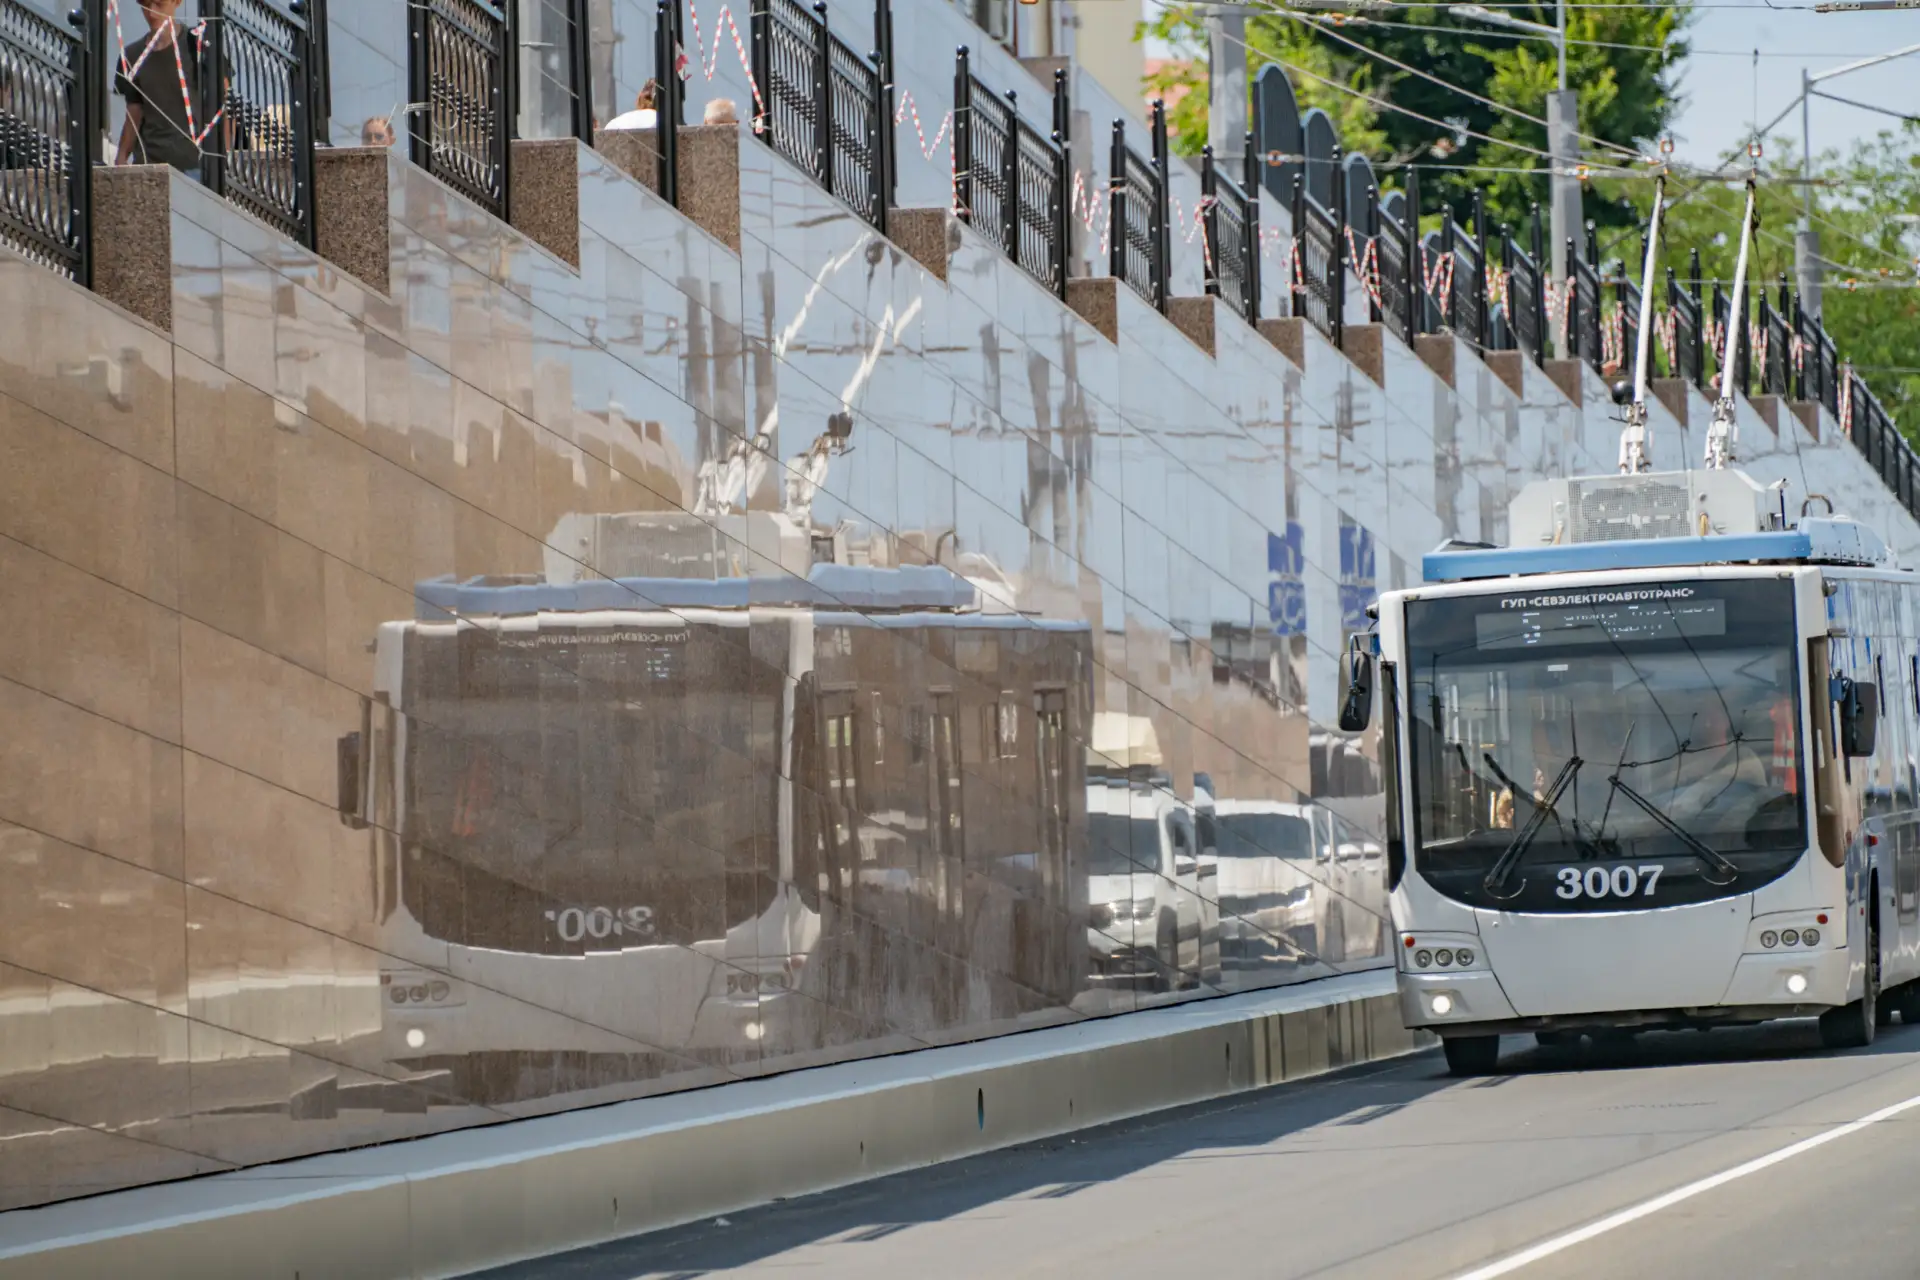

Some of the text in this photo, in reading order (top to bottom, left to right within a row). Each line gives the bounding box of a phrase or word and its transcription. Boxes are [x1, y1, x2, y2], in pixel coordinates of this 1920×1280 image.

[1501, 588, 1694, 608] ГУП «СЕВЭЛЕКТРОАВТОТРАНС»
[1556, 864, 1664, 899] 3007
